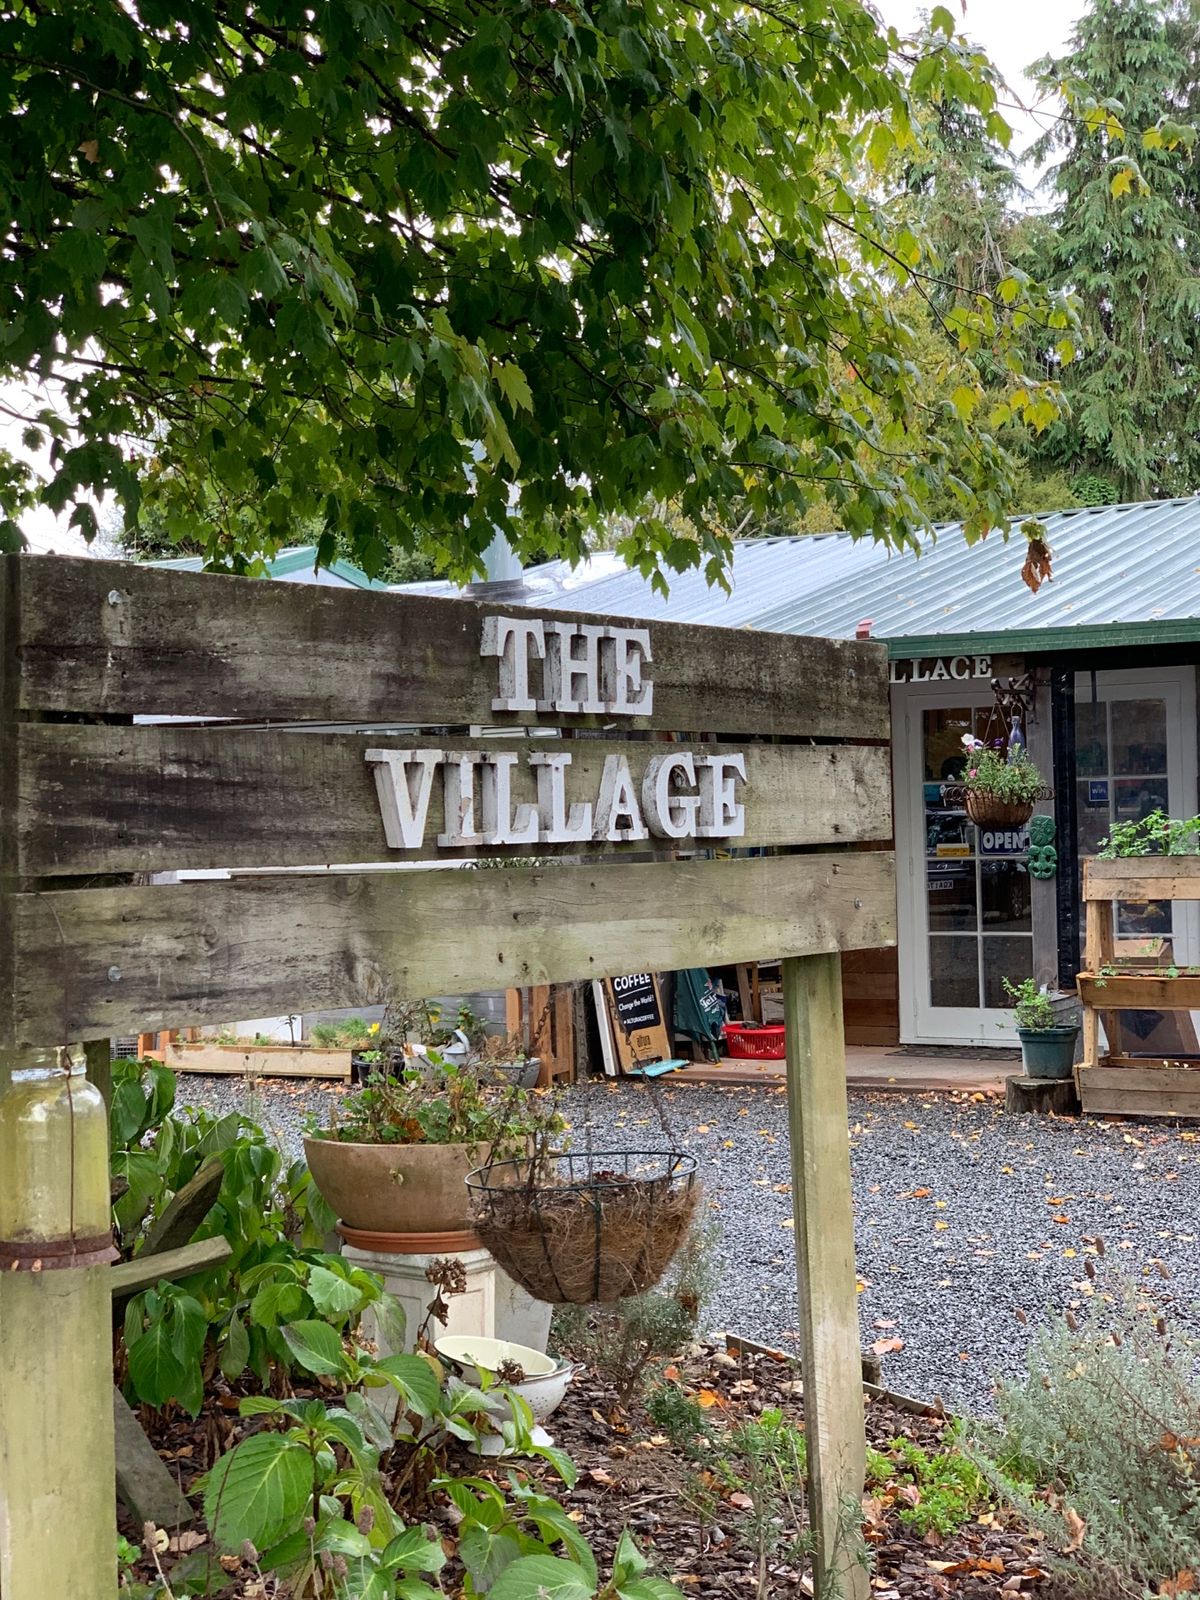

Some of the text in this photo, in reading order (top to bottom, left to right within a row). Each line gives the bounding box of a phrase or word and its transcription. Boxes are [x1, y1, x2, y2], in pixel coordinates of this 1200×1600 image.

[480, 616, 653, 715] THE
[365, 749, 747, 849] VILLAGE
[983, 831, 1024, 850] OPEN
[614, 973, 651, 991] COFFEE
[619, 1002, 634, 1011] Change
